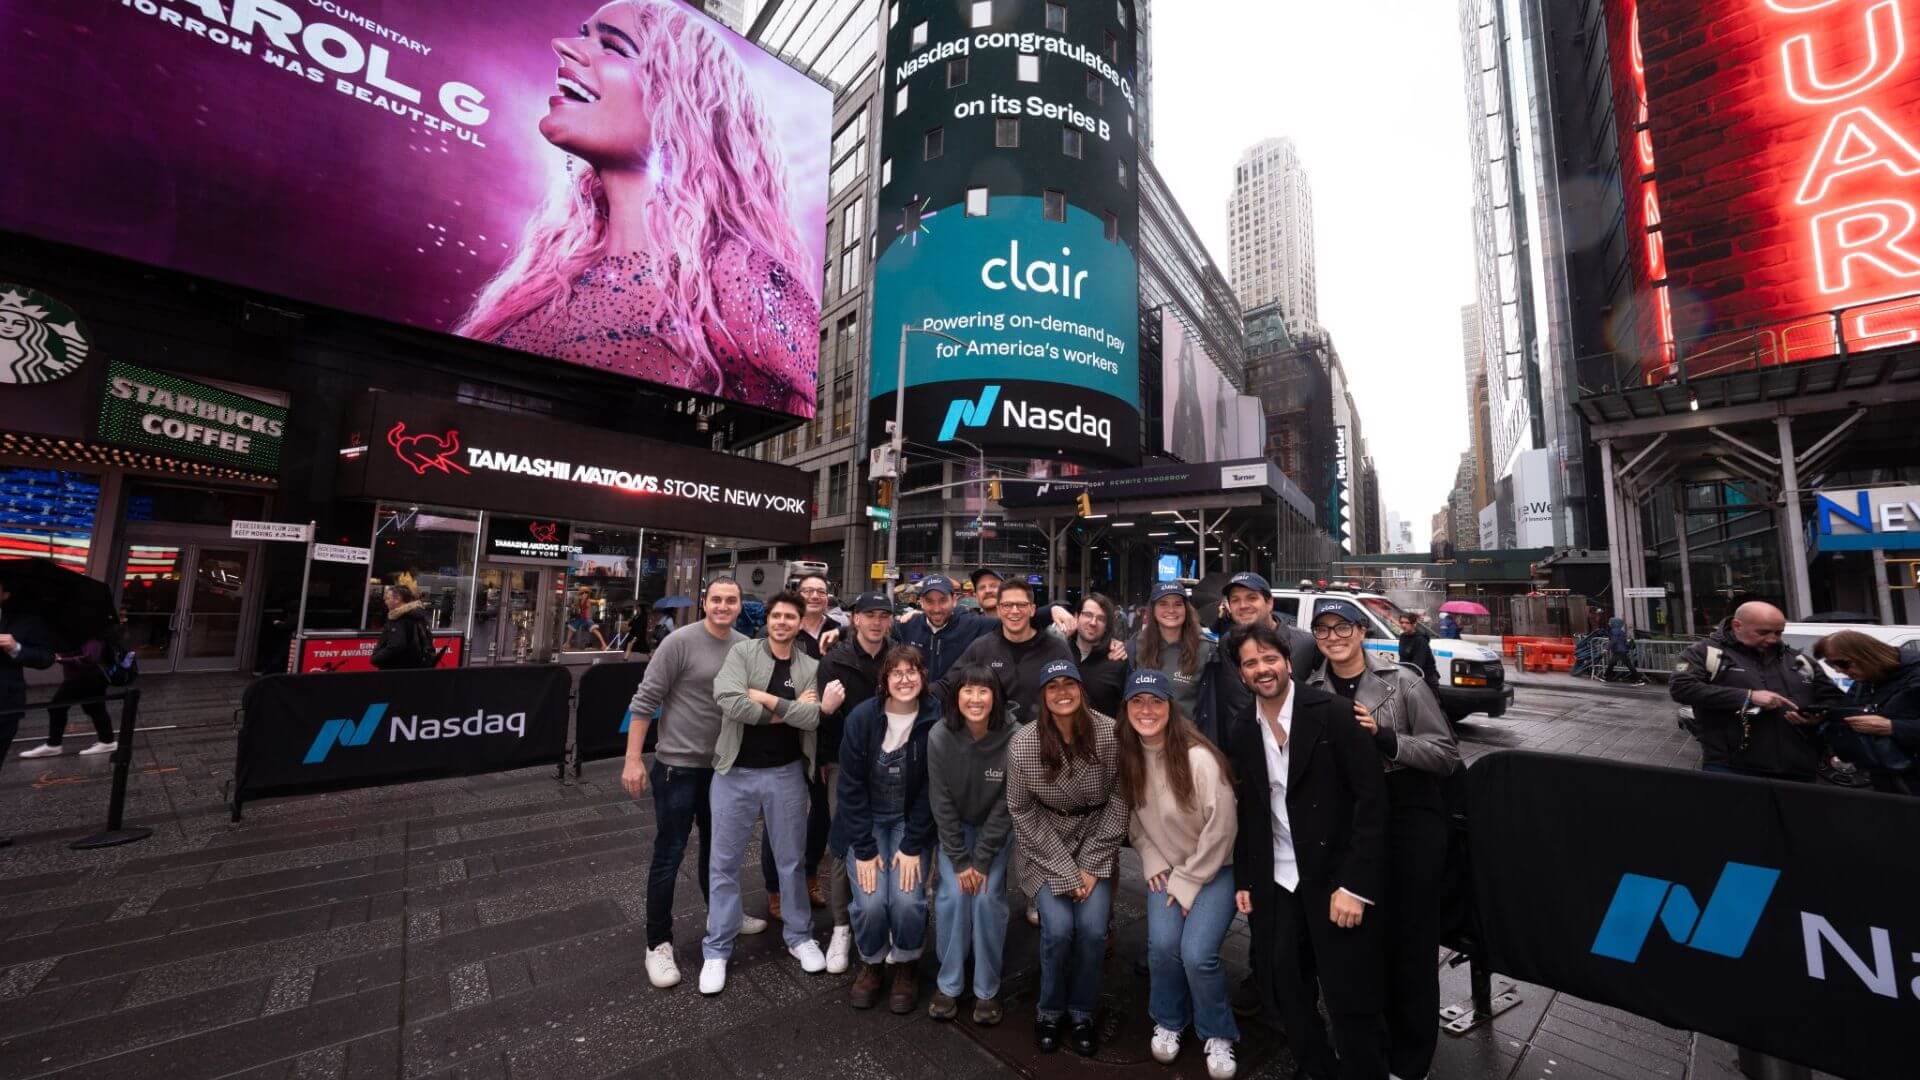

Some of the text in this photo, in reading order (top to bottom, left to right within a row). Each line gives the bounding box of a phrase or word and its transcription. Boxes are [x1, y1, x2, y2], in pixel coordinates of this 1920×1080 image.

[121, 0, 486, 148] ORROW WAS BEAUTIFUL
[896, 36, 970, 85] Nasdaq
[974, 32, 1119, 86] congratulates
[438, 81, 490, 126] G
[954, 94, 1110, 141] on its Series B
[981, 240, 1088, 299] clair
[923, 312, 1125, 354] Powering on-demand pay
[936, 340, 1119, 374] for America's workers
[110, 376, 283, 437] STARBUCKS
[1003, 400, 1111, 448] Nasdaq
[142, 414, 251, 454] COFFEE
[467, 448, 569, 481] TAMASHII
[664, 479, 720, 503] STORE
[725, 487, 761, 507] NEW
[763, 493, 806, 514] YORK
[560, 545, 583, 553] STORE
[1047, 662, 1068, 673] clair
[1135, 674, 1157, 683] clair
[389, 709, 526, 743] Nasdaq
[1800, 911, 1920, 1001] N
